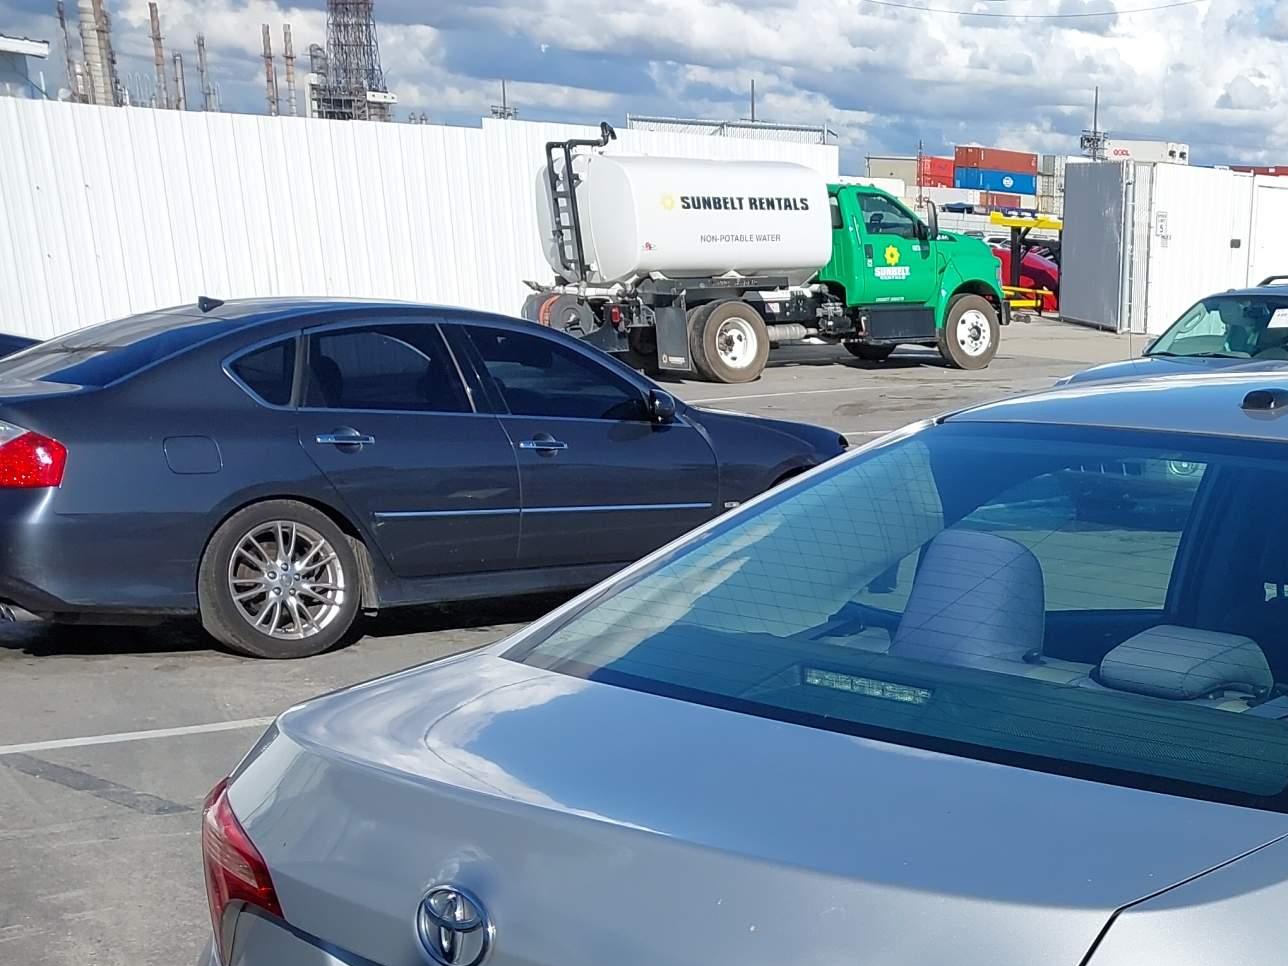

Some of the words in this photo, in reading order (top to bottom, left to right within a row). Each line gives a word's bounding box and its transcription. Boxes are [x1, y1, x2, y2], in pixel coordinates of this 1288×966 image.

[680, 196, 744, 210] SUNBELT
[748, 197, 810, 211] RENTALS
[700, 234, 754, 243] NON-POTABLE
[755, 233, 782, 243] WATER
